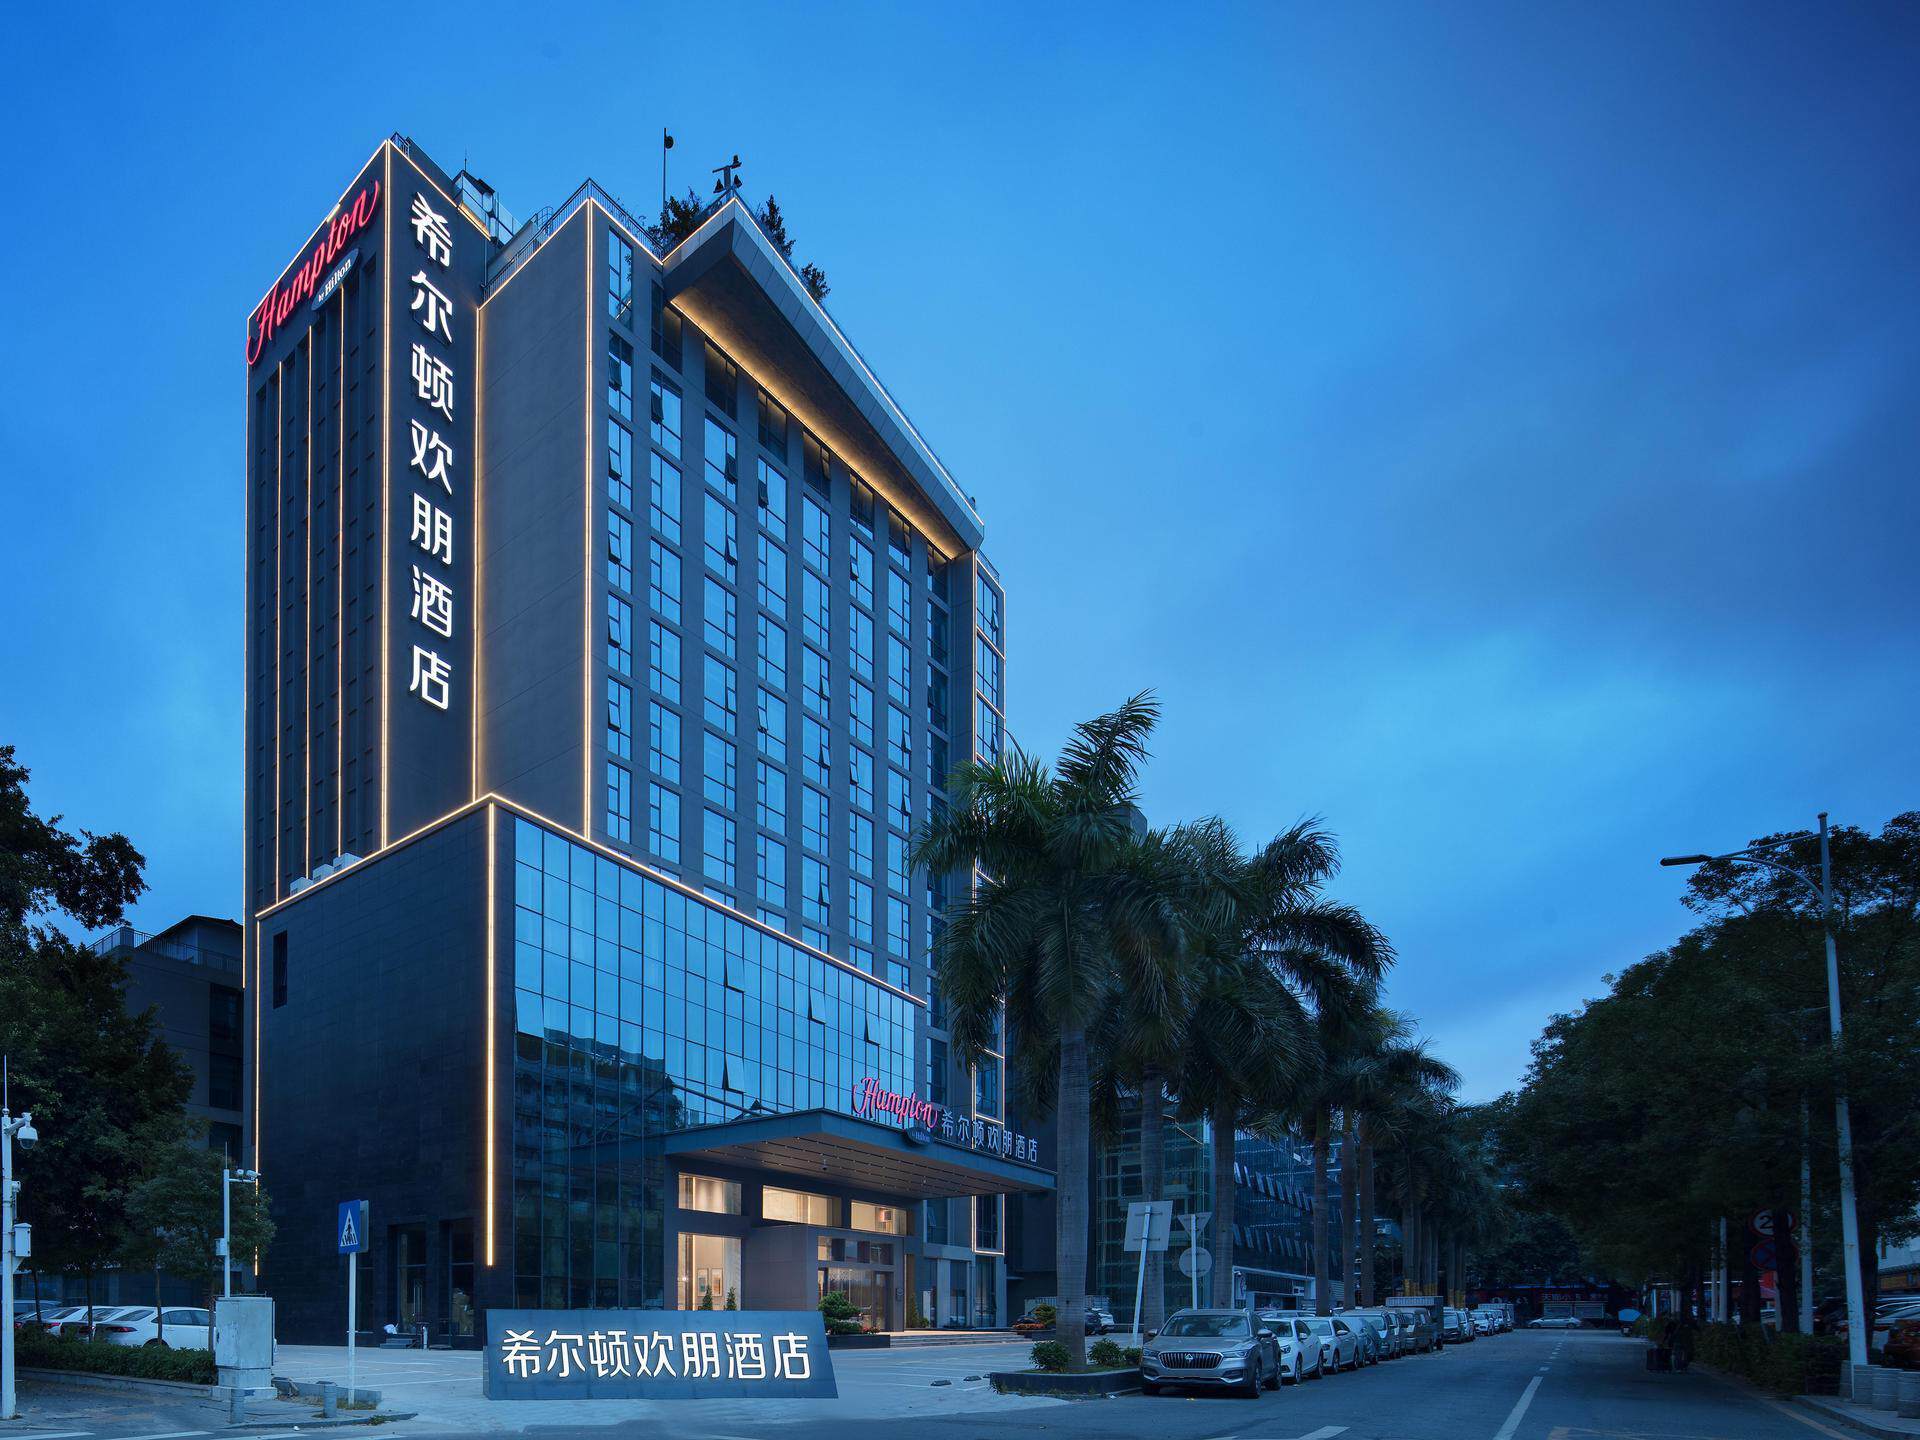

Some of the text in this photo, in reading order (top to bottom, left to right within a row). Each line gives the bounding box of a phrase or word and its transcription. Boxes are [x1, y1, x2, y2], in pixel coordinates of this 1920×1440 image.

[246, 180, 380, 366] Hampton
[325, 258, 352, 297] Hilton
[411, 192, 454, 711] 希尔顿欢朋酒店
[853, 1077, 938, 1129] Hampton
[941, 1109, 1038, 1163] 希尔顿欢朋酒店
[502, 1329, 811, 1379] 希尔顿欢朋酒店
